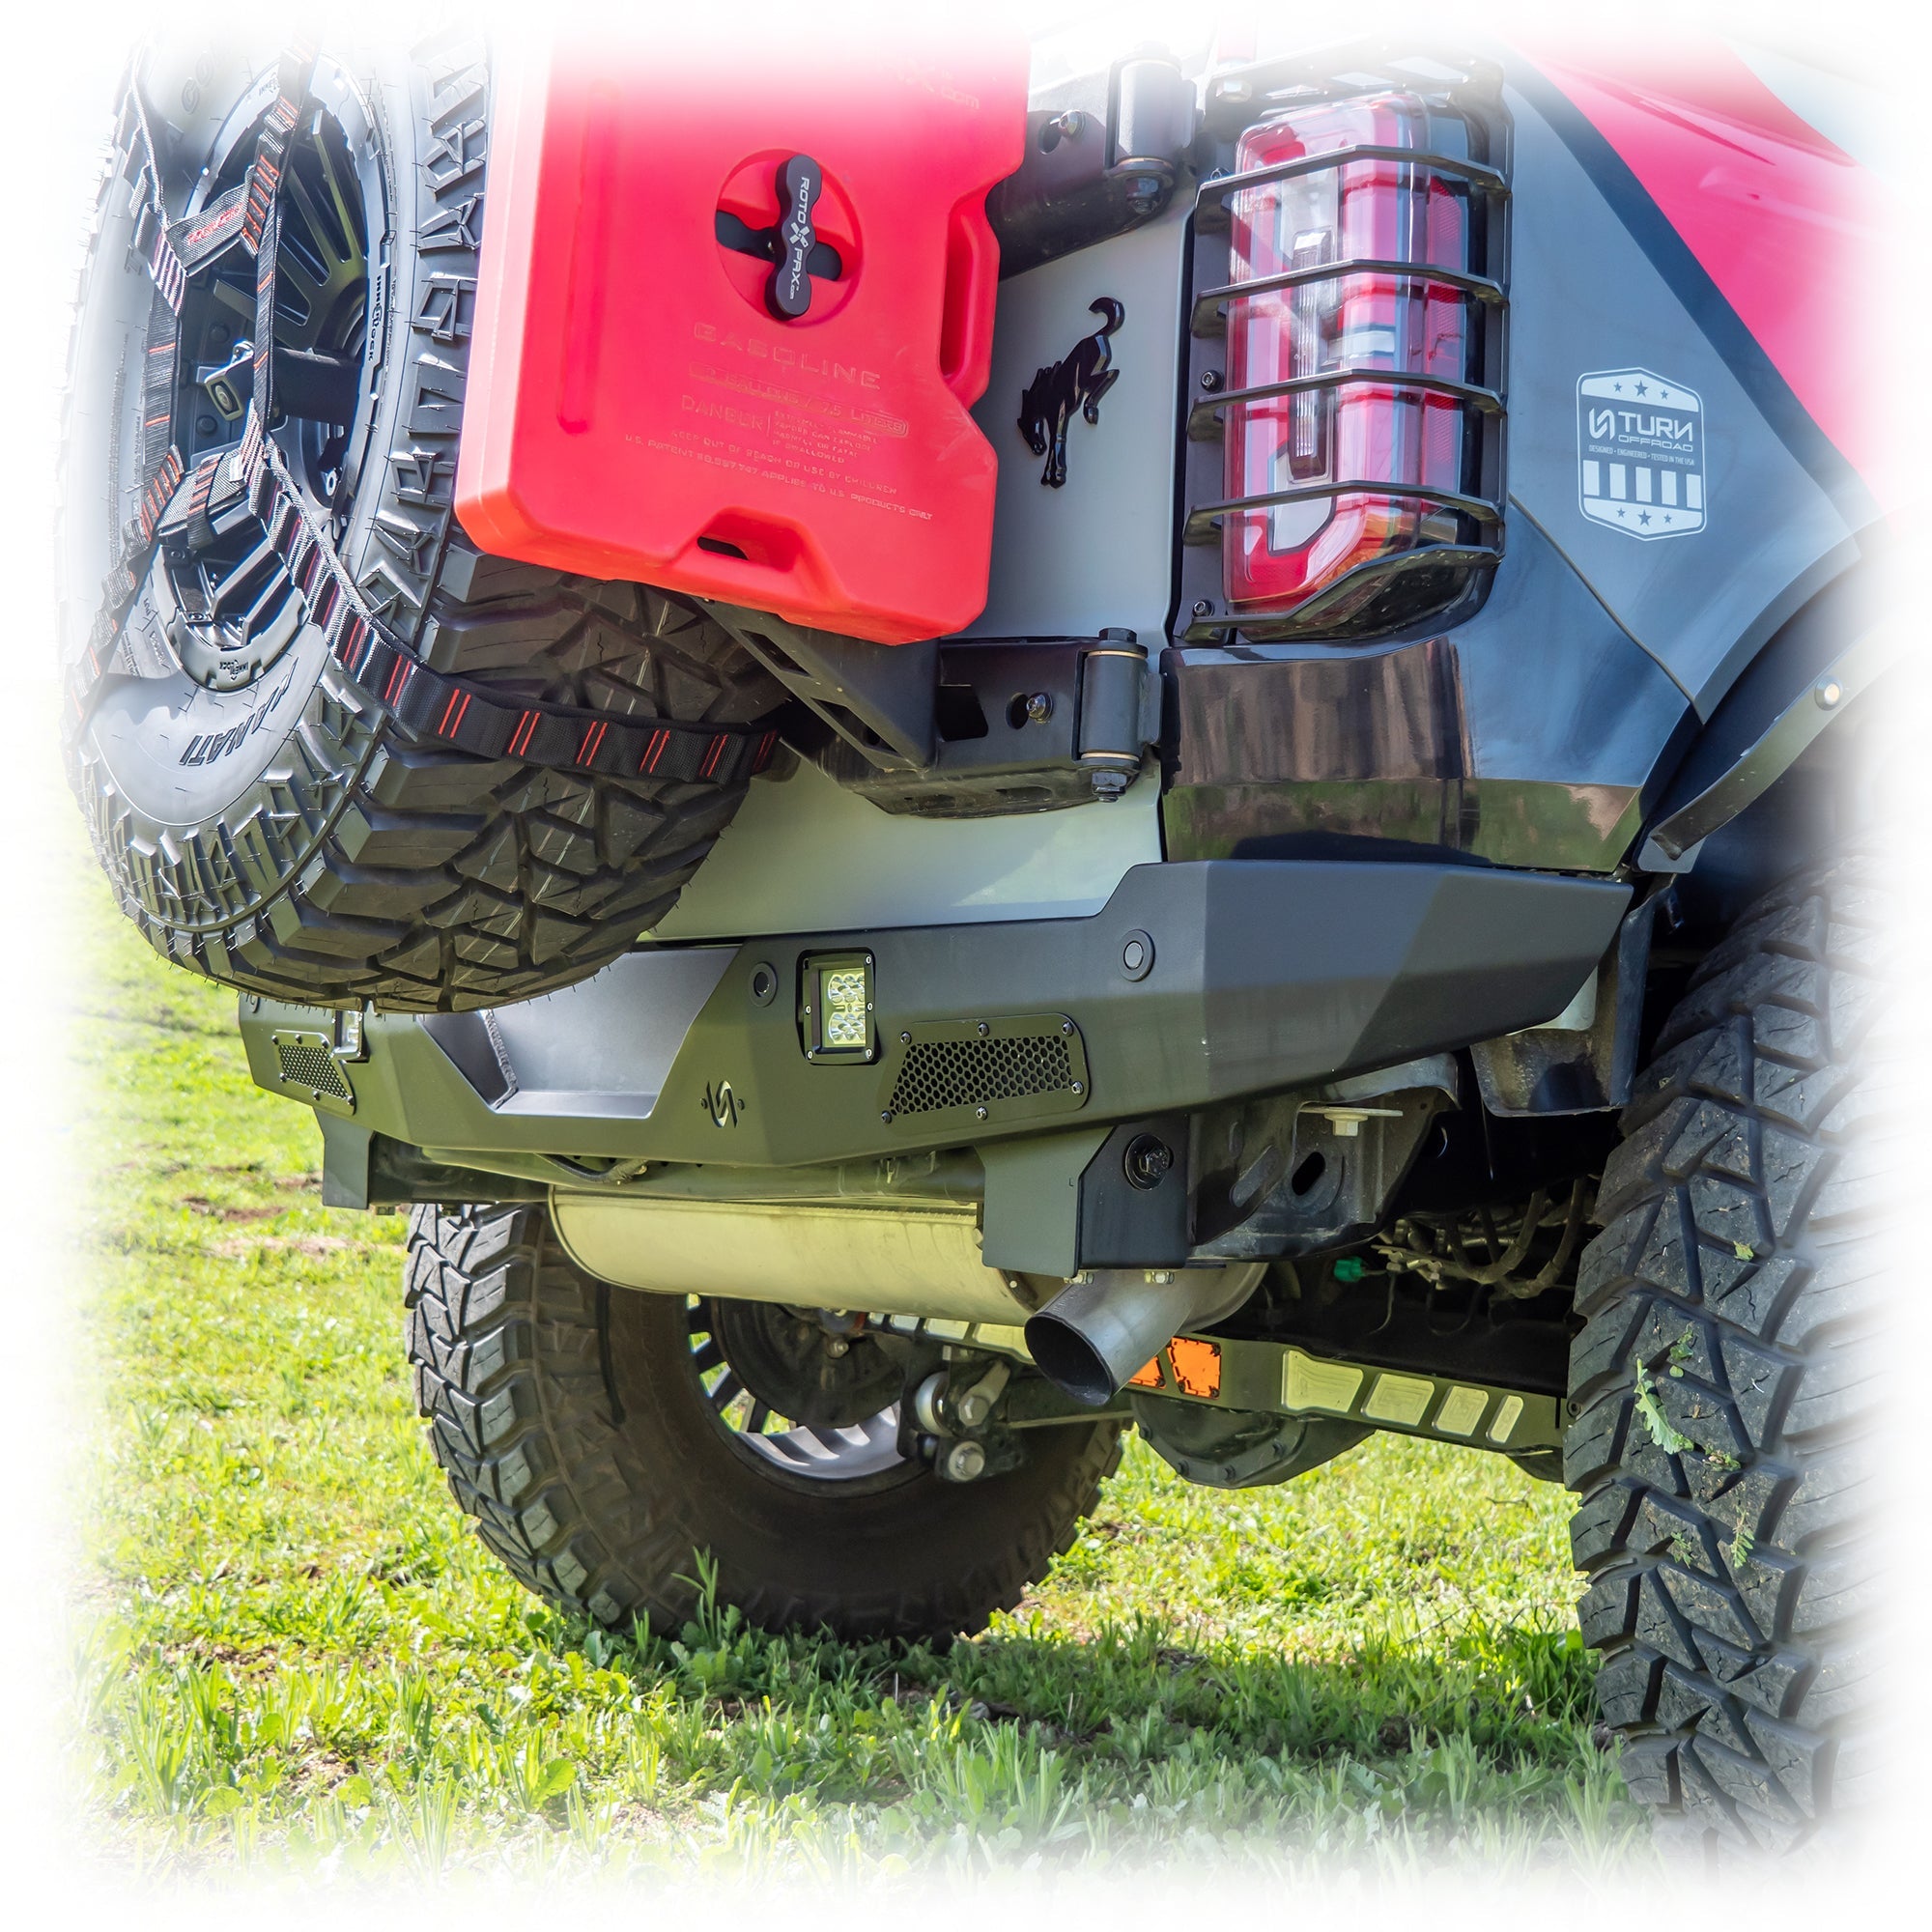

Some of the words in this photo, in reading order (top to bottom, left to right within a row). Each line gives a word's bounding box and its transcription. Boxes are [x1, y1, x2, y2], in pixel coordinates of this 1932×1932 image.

[797, 177, 810, 224] ROTO
[694, 321, 881, 391] GASOLINE
[1618, 411, 1693, 442] TURN
[1618, 434, 1693, 453] OFFROAD
[703, 437, 724, 448] OUT
[804, 465, 825, 477] USE
